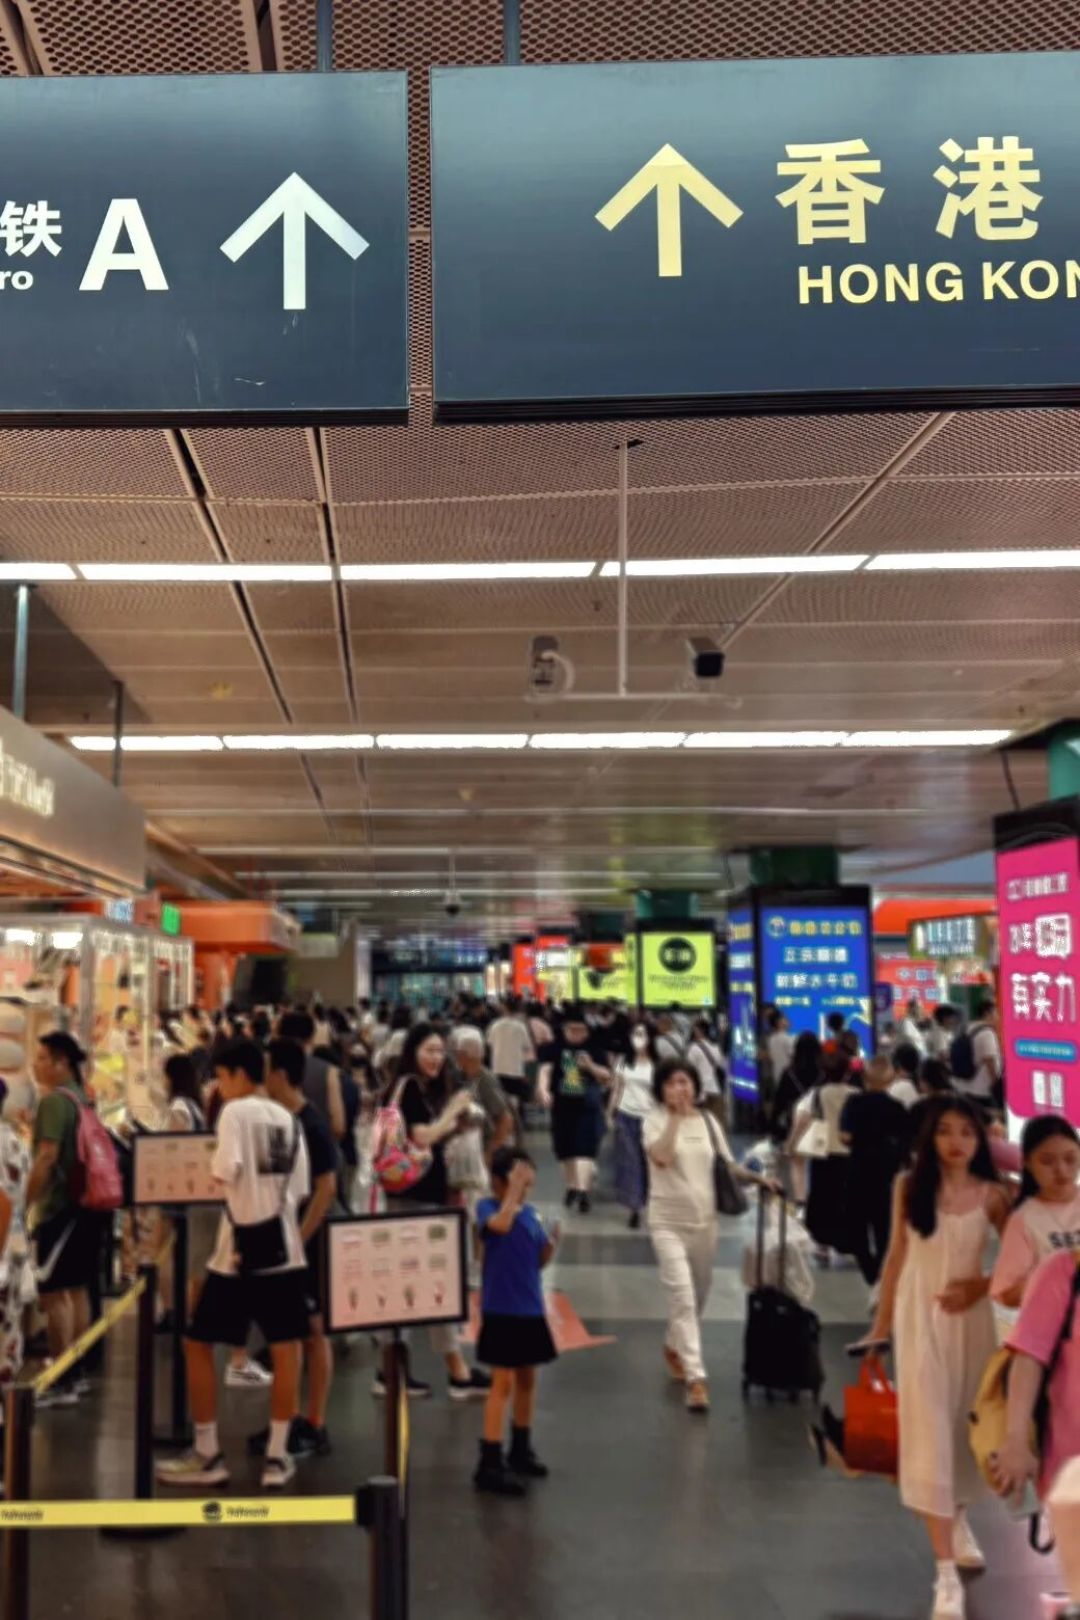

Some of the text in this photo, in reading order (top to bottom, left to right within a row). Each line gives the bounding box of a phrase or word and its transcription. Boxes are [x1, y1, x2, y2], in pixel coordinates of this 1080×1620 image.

[776, 136, 1043, 244] 香港
[0, 200, 62, 257] 铁
[79, 198, 169, 290] A
[798, 262, 964, 304] HONG
